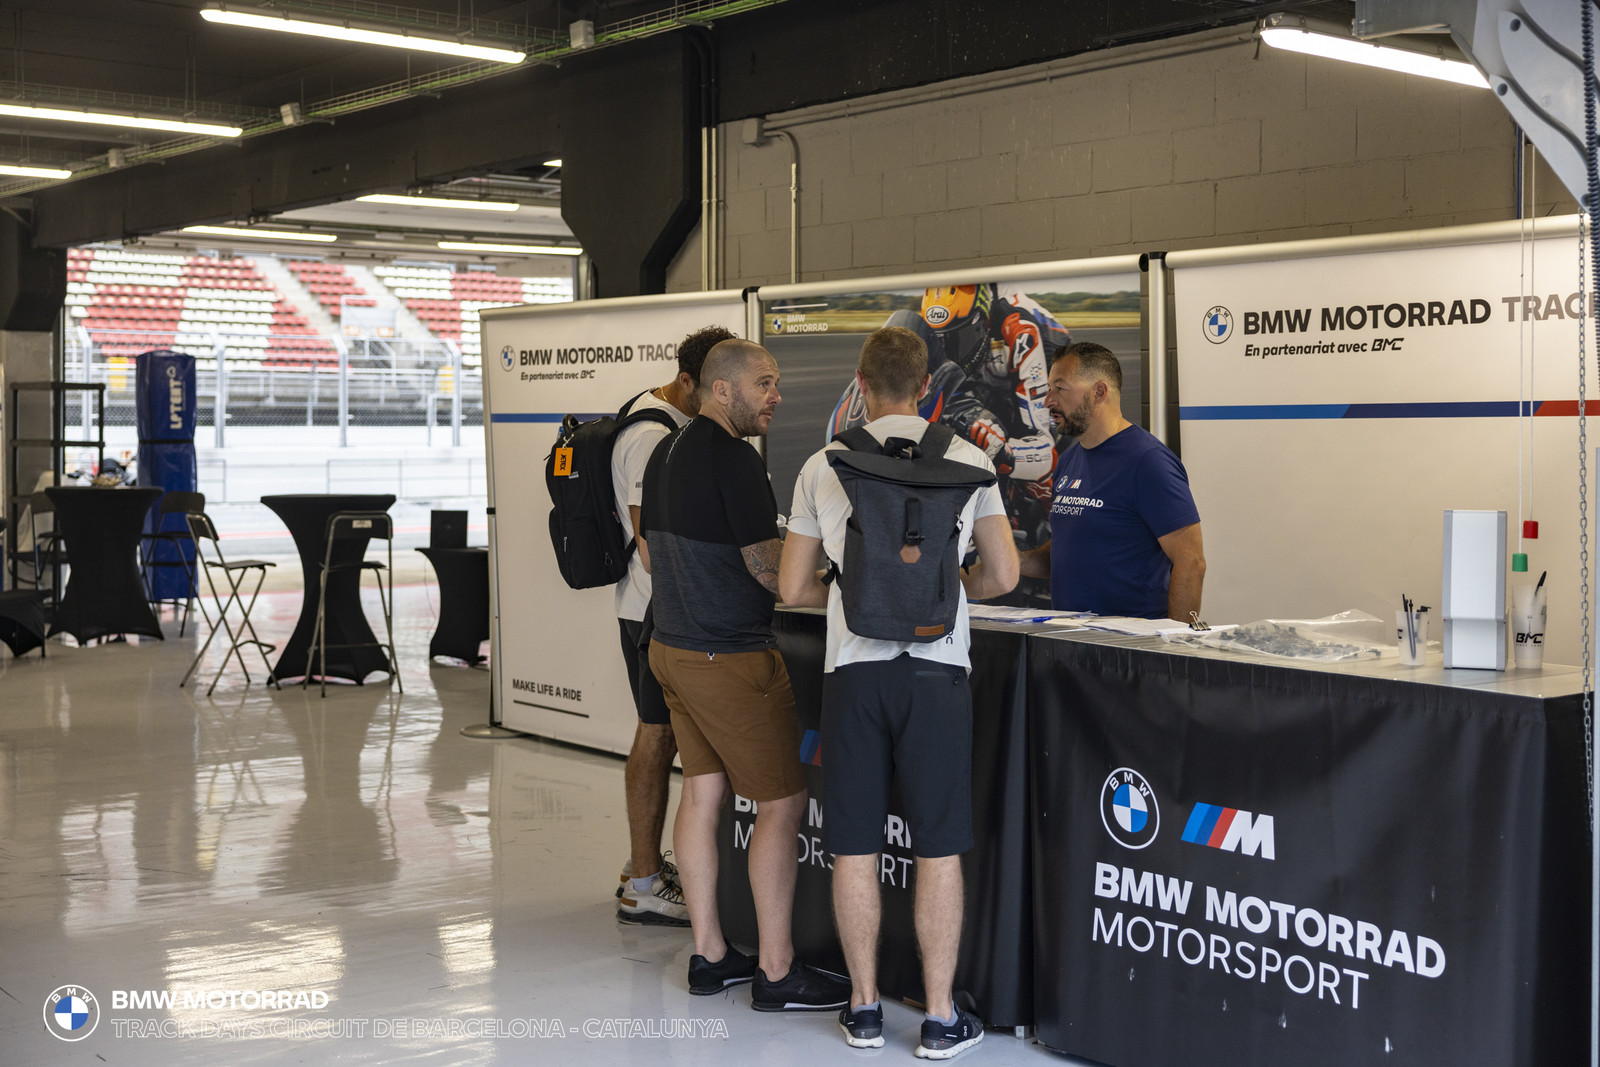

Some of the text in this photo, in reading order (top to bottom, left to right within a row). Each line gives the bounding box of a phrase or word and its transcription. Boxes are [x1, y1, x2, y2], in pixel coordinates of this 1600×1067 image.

[787, 314, 806, 323] BMW
[1244, 309, 1312, 335] BMW
[1321, 298, 1491, 332] MOTORRAD
[786, 323, 829, 334] MOTORRAD
[520, 349, 553, 366] BMW
[556, 345, 633, 364] MOTORRAD
[1245, 338, 1404, 359] En partenariat avec BMC
[521, 372, 528, 381] En
[529, 371, 564, 382] partenariat
[1050, 504, 1084, 516] TORSPORT
[1061, 496, 1104, 508] MOTORRAD
[1516, 632, 1544, 644] BMC
[512, 678, 582, 702] MAKE LIFE A RIDE
[1109, 772, 1150, 797] BMW
[1220, 809, 1275, 860] M
[1094, 862, 1446, 978] BMW MOTORRAD
[1092, 908, 1369, 1009] MOTORSPORT
